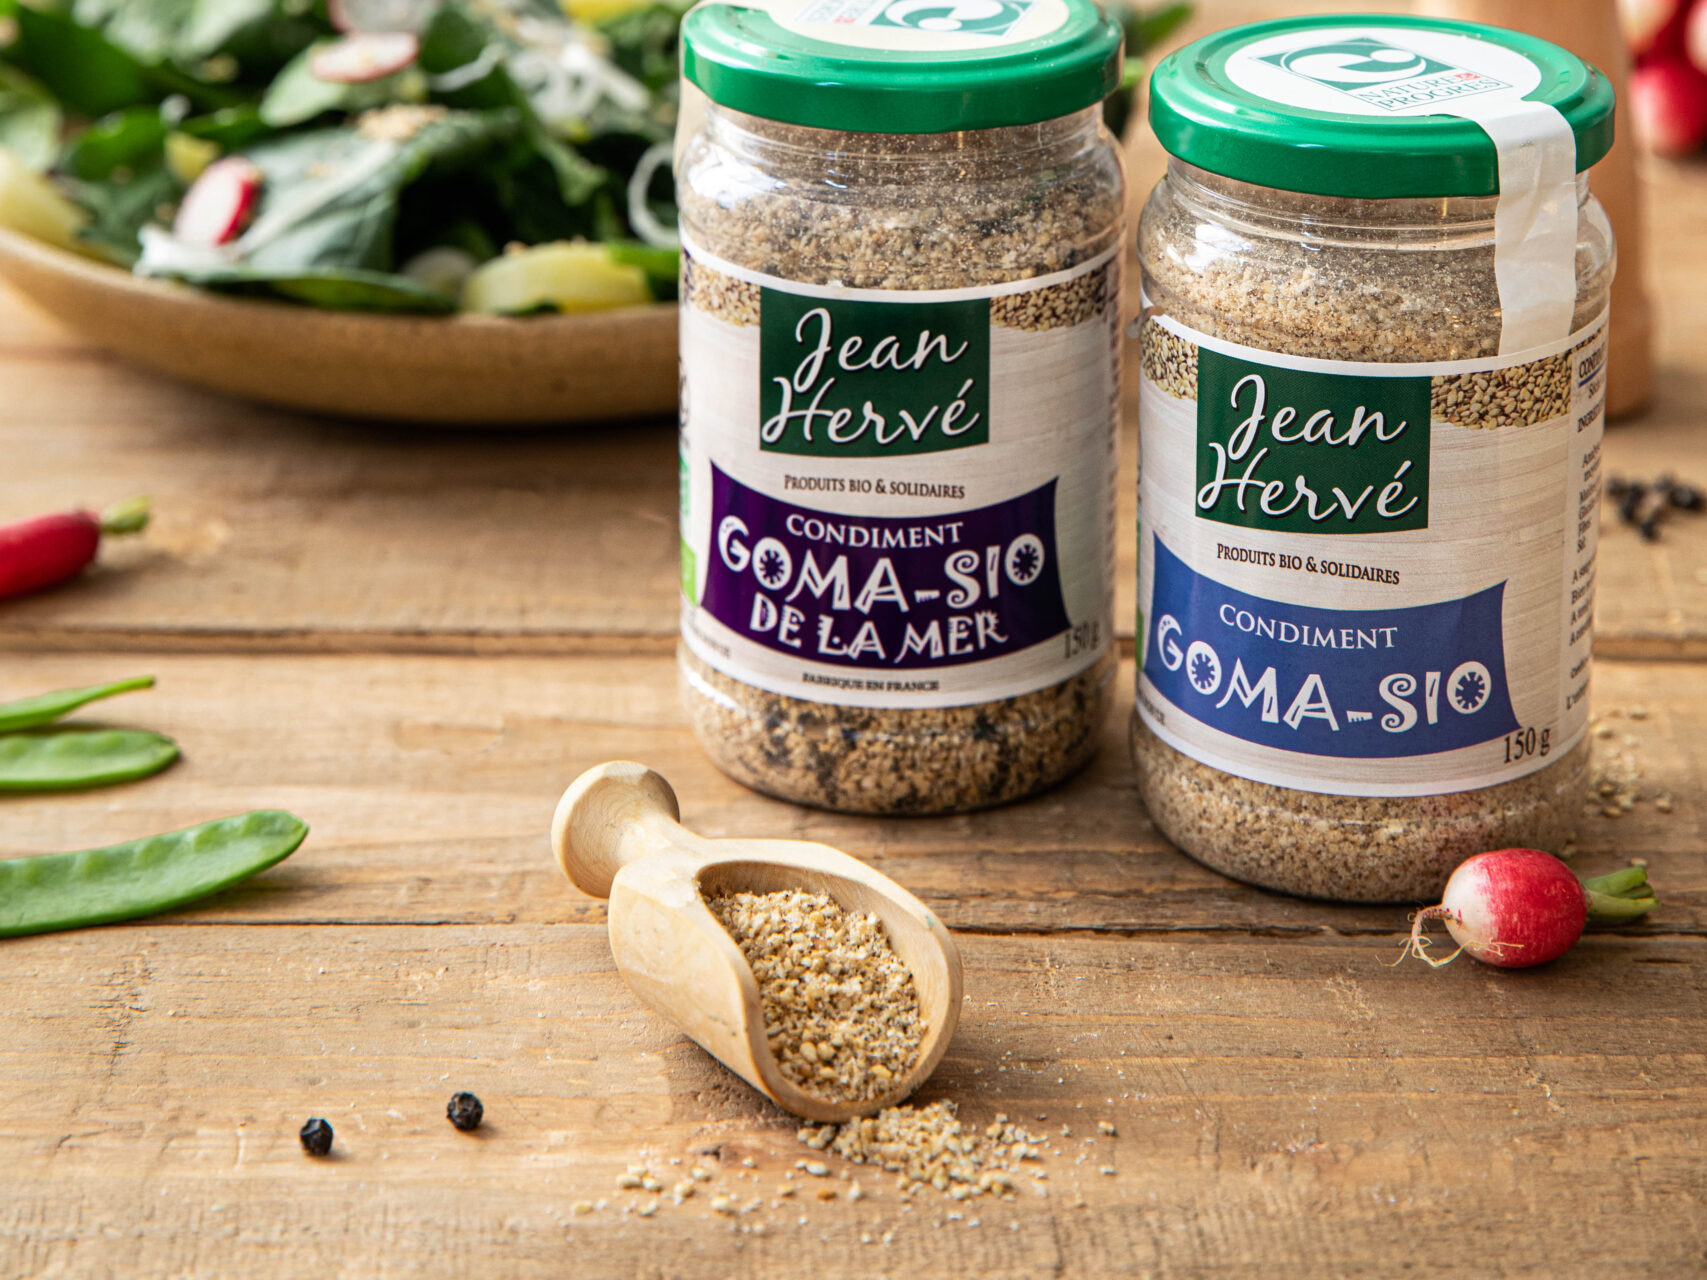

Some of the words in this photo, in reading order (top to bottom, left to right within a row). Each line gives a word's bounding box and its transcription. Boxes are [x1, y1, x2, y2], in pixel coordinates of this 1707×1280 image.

[1360, 75, 1463, 101] NATURE
[793, 307, 969, 394] Jean
[761, 376, 981, 445] Hervé
[1228, 374, 1407, 460] Jean
[784, 474, 845, 493] PRODUITS
[849, 476, 872, 494] BIO
[875, 478, 887, 495] &
[889, 480, 965, 499] SOLIDAIRES
[1197, 442, 1419, 520] Hervé
[786, 513, 964, 549] CONDIMENT
[718, 515, 1045, 614] GOMA-SIO
[1217, 543, 1275, 567] PRODUITS
[1279, 553, 1301, 571] BIO
[1305, 556, 1318, 573] &
[1321, 560, 1400, 585] SOLIDAIRES
[750, 591, 806, 648] DE
[817, 614, 887, 660] LA
[893, 610, 1009, 664] MER
[1220, 604, 1398, 649] CONDIMENT
[865, 680, 884, 692] EN
[886, 680, 940, 692] FRANCE
[1157, 614, 1492, 733] GOMA-SIO
[1503, 727, 1536, 764] 150
[1540, 727, 1551, 757] g
